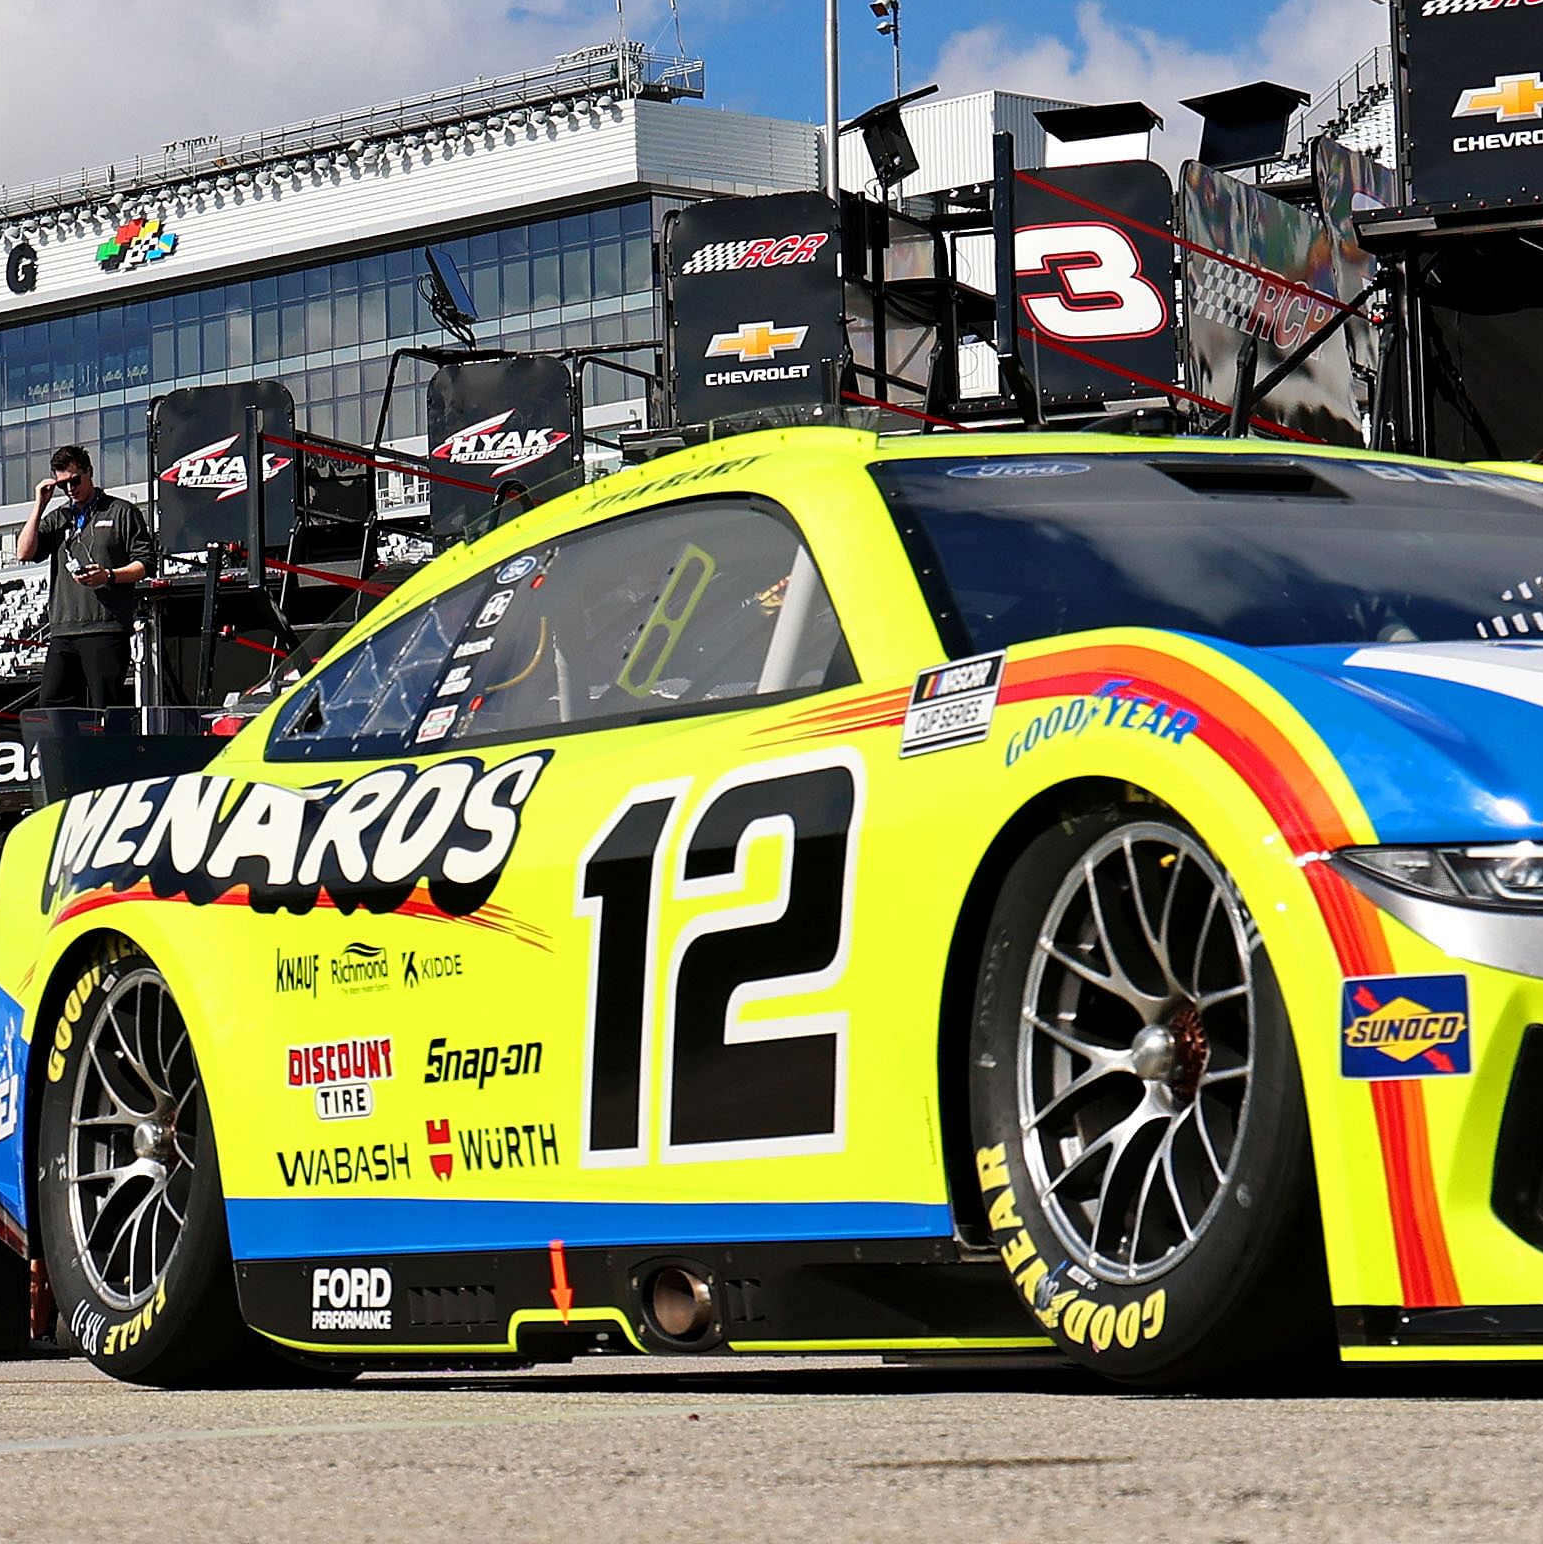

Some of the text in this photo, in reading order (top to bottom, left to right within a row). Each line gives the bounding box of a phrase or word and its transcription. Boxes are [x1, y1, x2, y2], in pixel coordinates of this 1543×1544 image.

[736, 232, 830, 271] RCR
[1013, 220, 1168, 343] 3
[704, 363, 812, 387] CHEVROLET
[449, 427, 554, 456] HYAK
[449, 444, 550, 464] MOTORSPORTS
[914, 699, 984, 735] CUP SERIES
[1005, 679, 1200, 768] GOODYEAR
[47, 753, 553, 891] MENARDS
[275, 947, 320, 1000] KNAUF
[330, 947, 390, 985] Richmond
[420, 953, 464, 980] KIDDE
[579, 756, 860, 1159] 12
[1351, 1012, 1459, 1046] SUNOCO
[288, 1037, 393, 1087] DISCOUNT
[424, 1037, 543, 1090] Snap-on
[320, 1088, 368, 1116] TIRE
[276, 1141, 411, 1188] WABASH
[458, 1122, 560, 1172] WÜRTH
[975, 1141, 1167, 1351] GOODYEAR
[311, 1267, 392, 1309] FORD
[311, 1310, 393, 1331] PERFORMANCE
